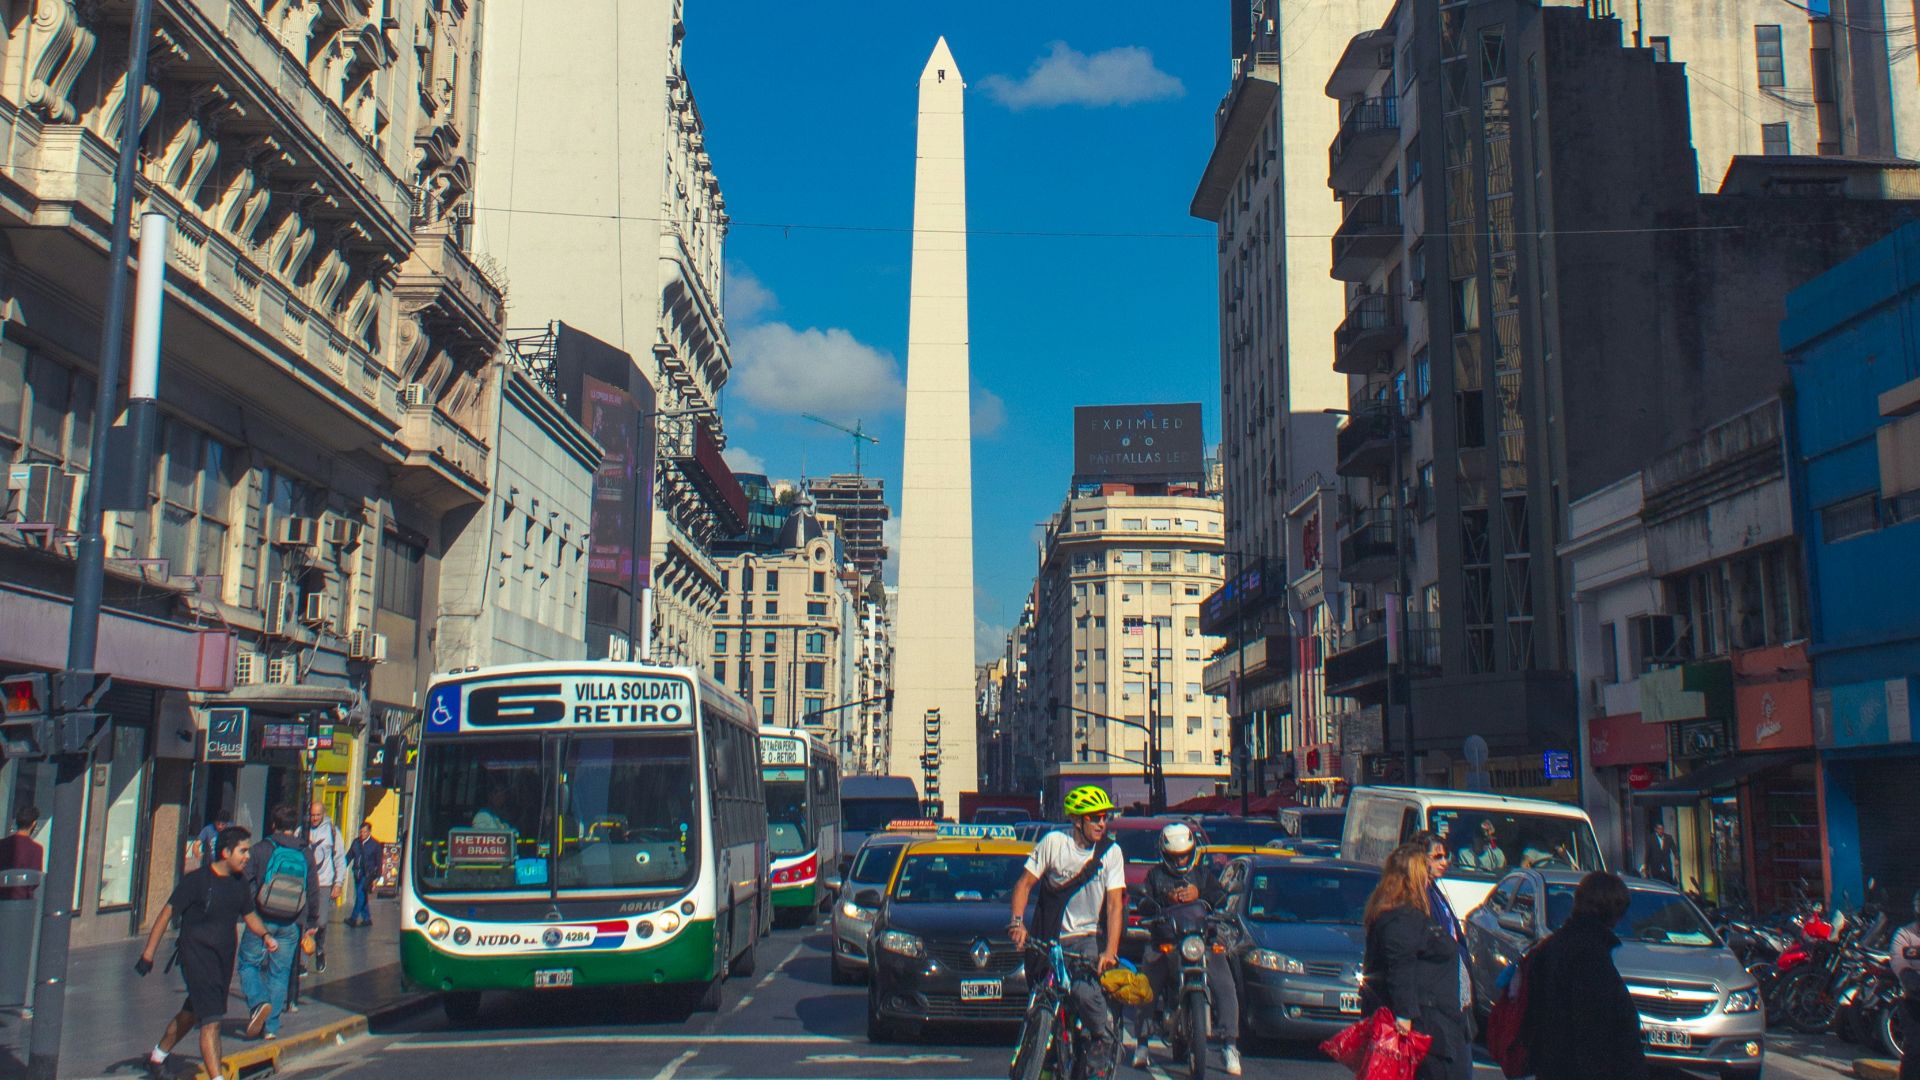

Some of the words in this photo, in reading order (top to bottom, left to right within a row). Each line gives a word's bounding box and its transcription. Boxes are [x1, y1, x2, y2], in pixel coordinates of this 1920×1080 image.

[1091, 418, 1183, 431] EXPIMLED
[1089, 452, 1161, 464] PANTALLAS
[576, 683, 617, 700] VILLA
[621, 682, 683, 700] SOLDATI
[468, 683, 566, 727] 6
[574, 704, 682, 723] RETIRO
[208, 741, 242, 751] Claus
[952, 827, 978, 836] NEW
[981, 826, 1012, 837] TAXI
[455, 835, 506, 845] RETIRO
[468, 846, 505, 855] BRASIL
[620, 901, 664, 912] AGRALE
[476, 934, 521, 946] NUDO
[565, 932, 590, 941] 4284
